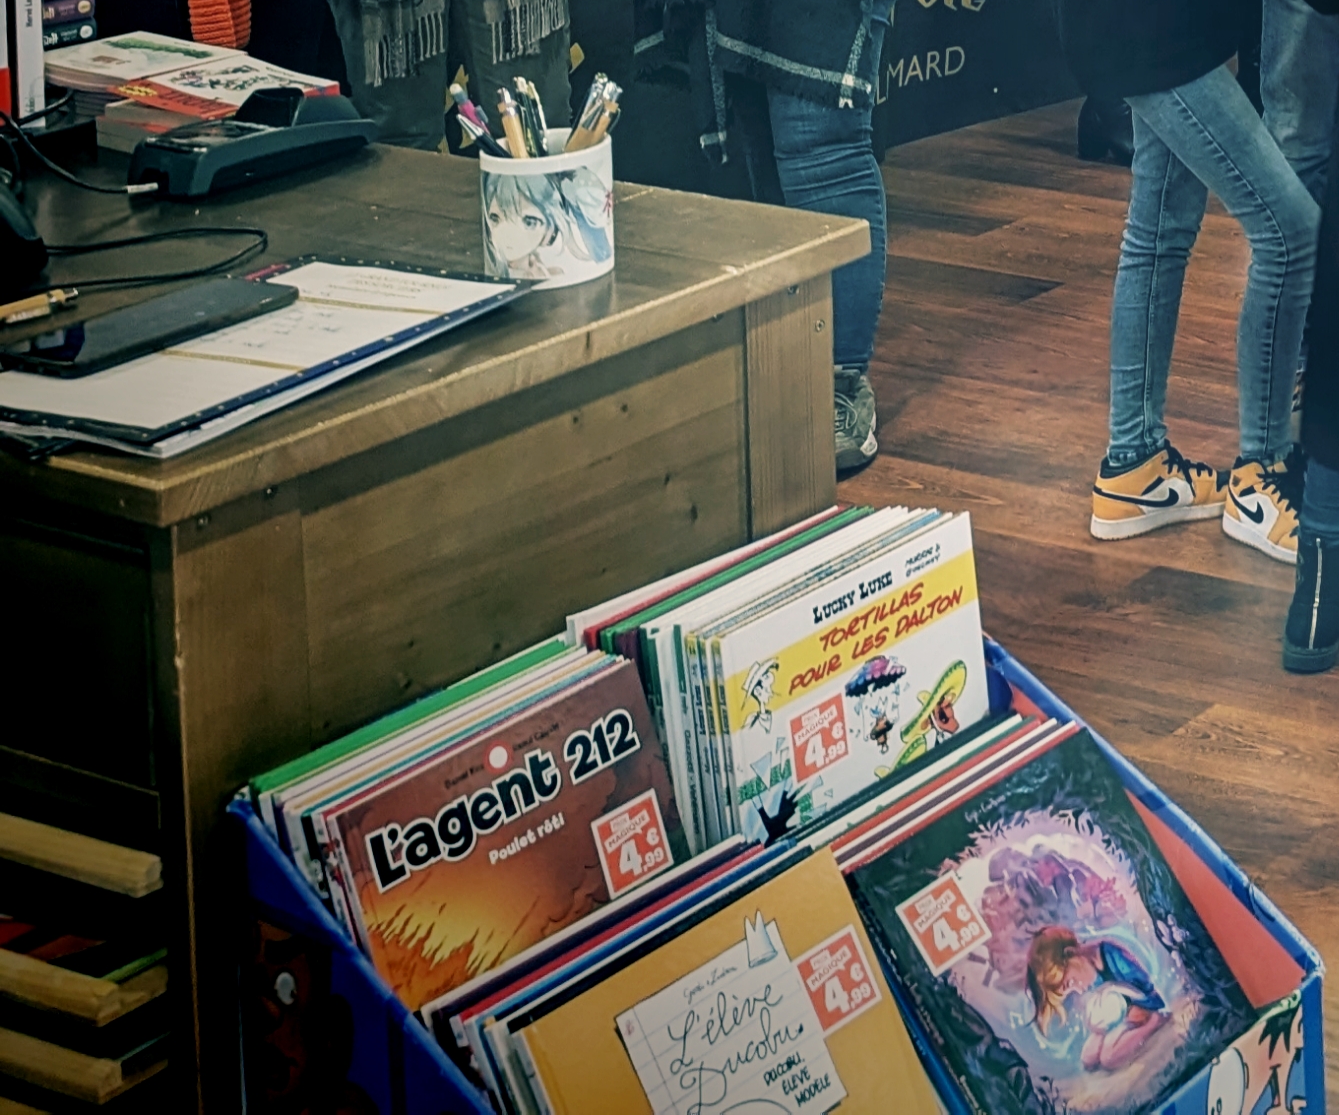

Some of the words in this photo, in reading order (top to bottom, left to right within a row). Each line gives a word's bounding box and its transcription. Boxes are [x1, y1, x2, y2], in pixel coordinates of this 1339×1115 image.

[813, 590, 855, 624] LUCKY
[859, 571, 893, 599] LUKE
[819, 582, 924, 651] TORTILLAS
[789, 654, 842, 696] POUR
[851, 626, 889, 660] LES
[894, 585, 963, 638] DALTON
[798, 709, 836, 740] MAGIQUE
[366, 749, 562, 893] L'agent
[563, 709, 640, 785] 212
[489, 827, 537, 865] Poulet
[539, 812, 566, 840] rôti
[607, 813, 648, 848] MAGIQUE
[917, 894, 952, 928] MAGIQUE
[810, 950, 848, 986] MAGIQUE
[667, 984, 783, 1076] L'élève
